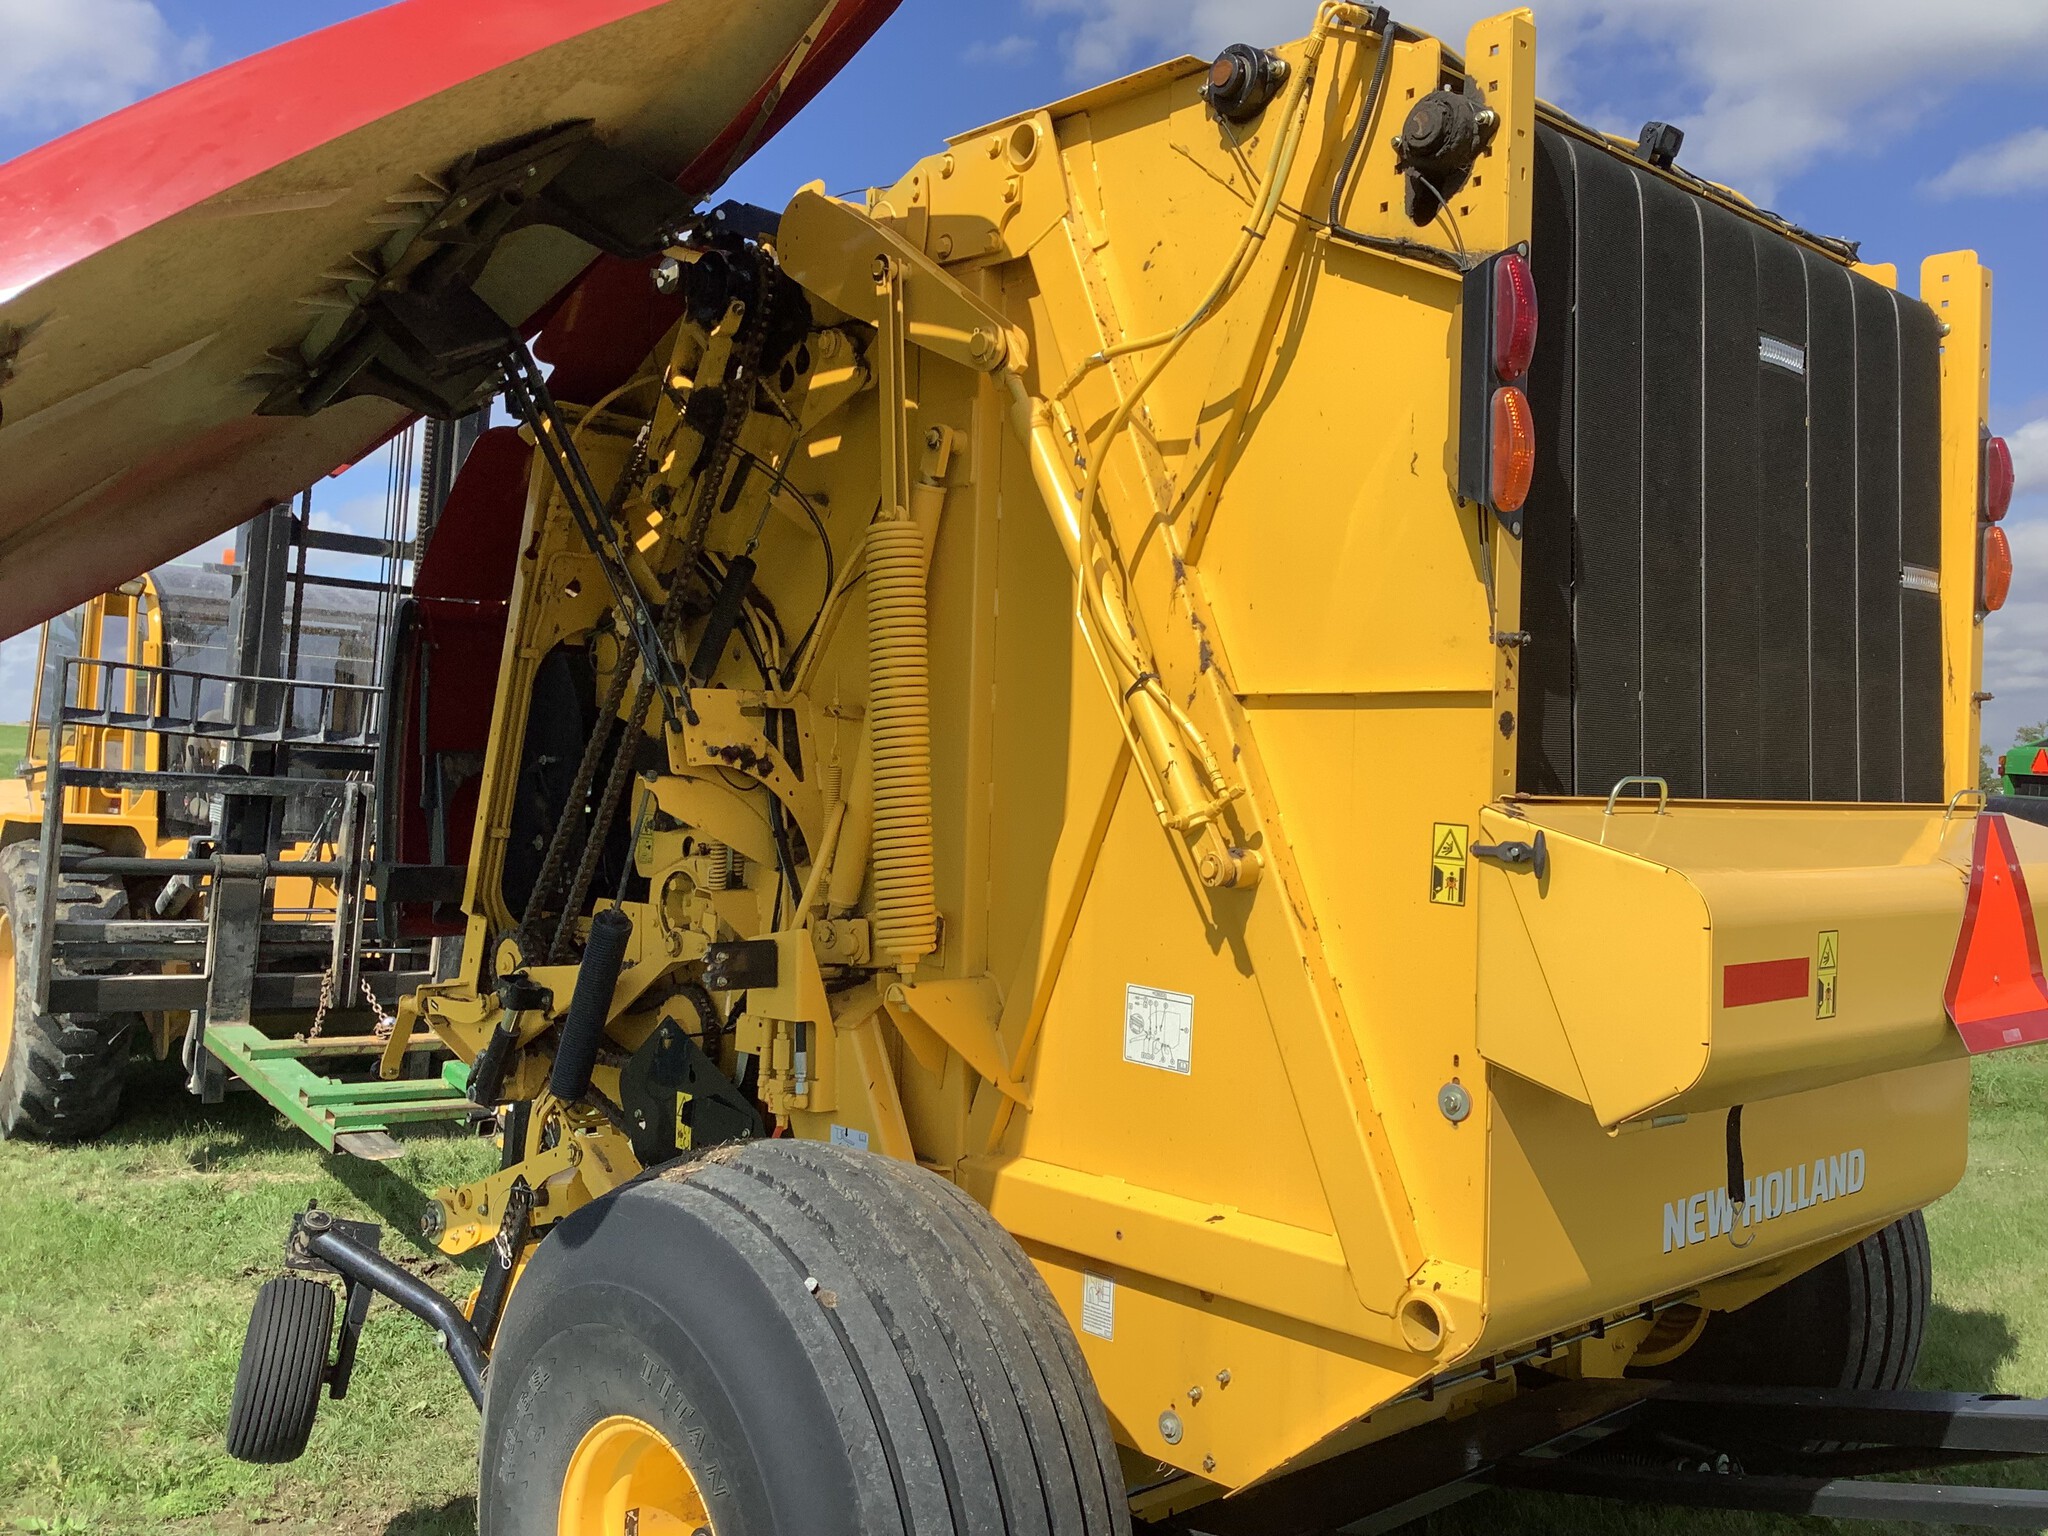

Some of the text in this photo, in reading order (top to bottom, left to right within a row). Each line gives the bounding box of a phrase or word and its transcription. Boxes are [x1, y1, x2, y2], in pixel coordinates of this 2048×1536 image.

[1664, 1148, 1866, 1254] NEW HOLLAND
[640, 1353, 731, 1498] TITAN
